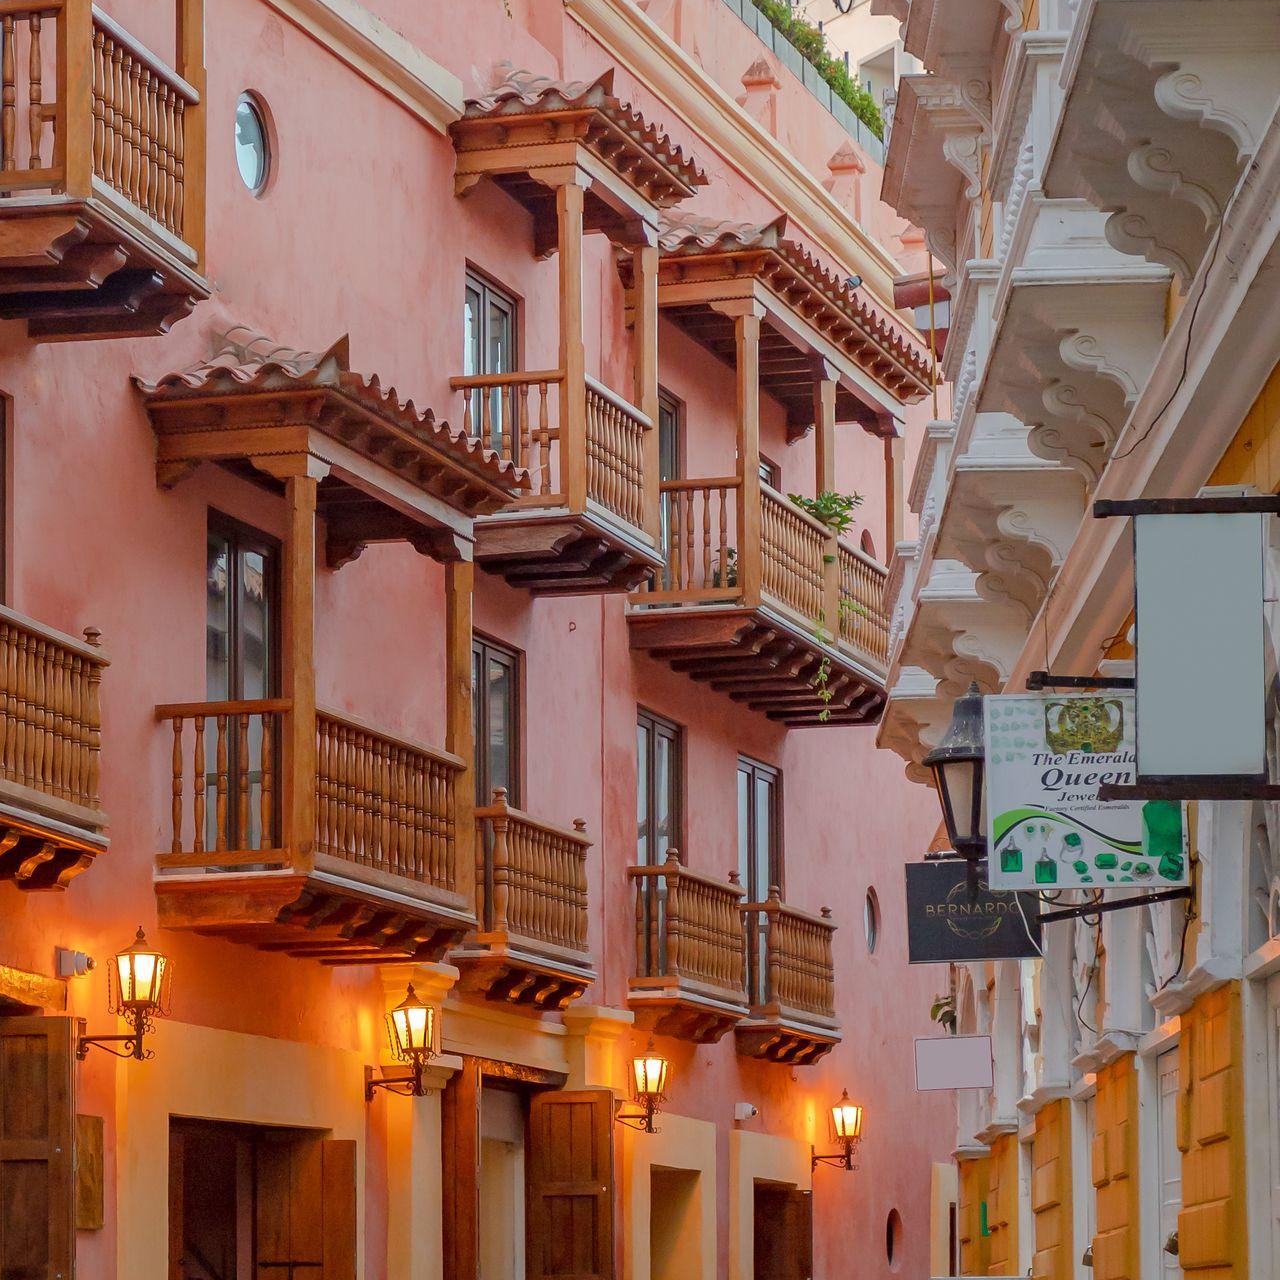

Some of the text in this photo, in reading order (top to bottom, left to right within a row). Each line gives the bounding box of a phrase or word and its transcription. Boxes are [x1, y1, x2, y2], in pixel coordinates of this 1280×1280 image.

[1032, 753, 1063, 766] The
[1041, 768, 1132, 791] Queen
[926, 901, 1020, 918] BERNARDO
